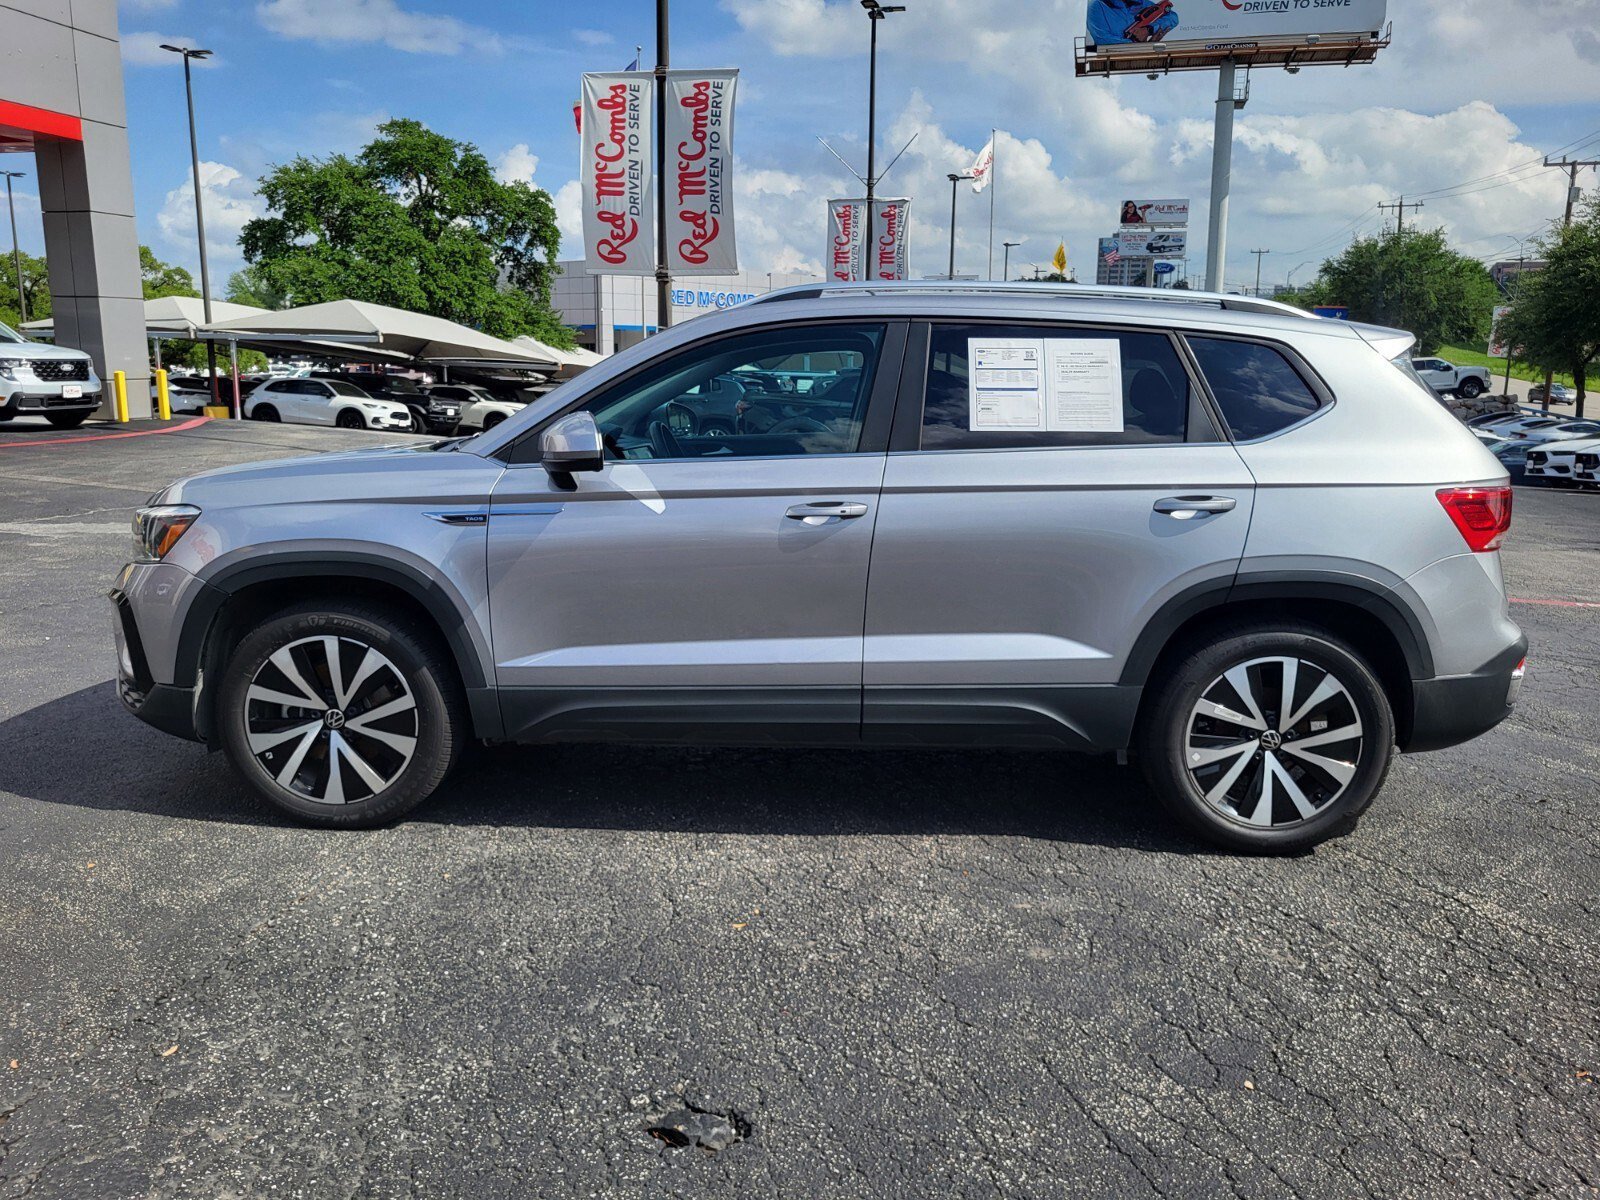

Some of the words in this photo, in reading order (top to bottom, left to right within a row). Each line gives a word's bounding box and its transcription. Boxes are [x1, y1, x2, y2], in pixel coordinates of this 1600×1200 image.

[1243, 1, 1289, 12] DRIVEN
[1294, 0, 1310, 9] TO
[1313, 0, 1351, 8] SERVE
[628, 84, 640, 130] SERVE
[710, 81, 723, 127] SERVE
[595, 84, 627, 206] McCombs
[628, 133, 640, 155] TO
[678, 81, 711, 206] McCombs
[709, 131, 721, 153] TO
[628, 159, 641, 217] DRIVEN
[709, 157, 721, 215] DRIVEN
[596, 210, 639, 265] Red
[678, 209, 720, 265] Red
[852, 231, 859, 242] TO
